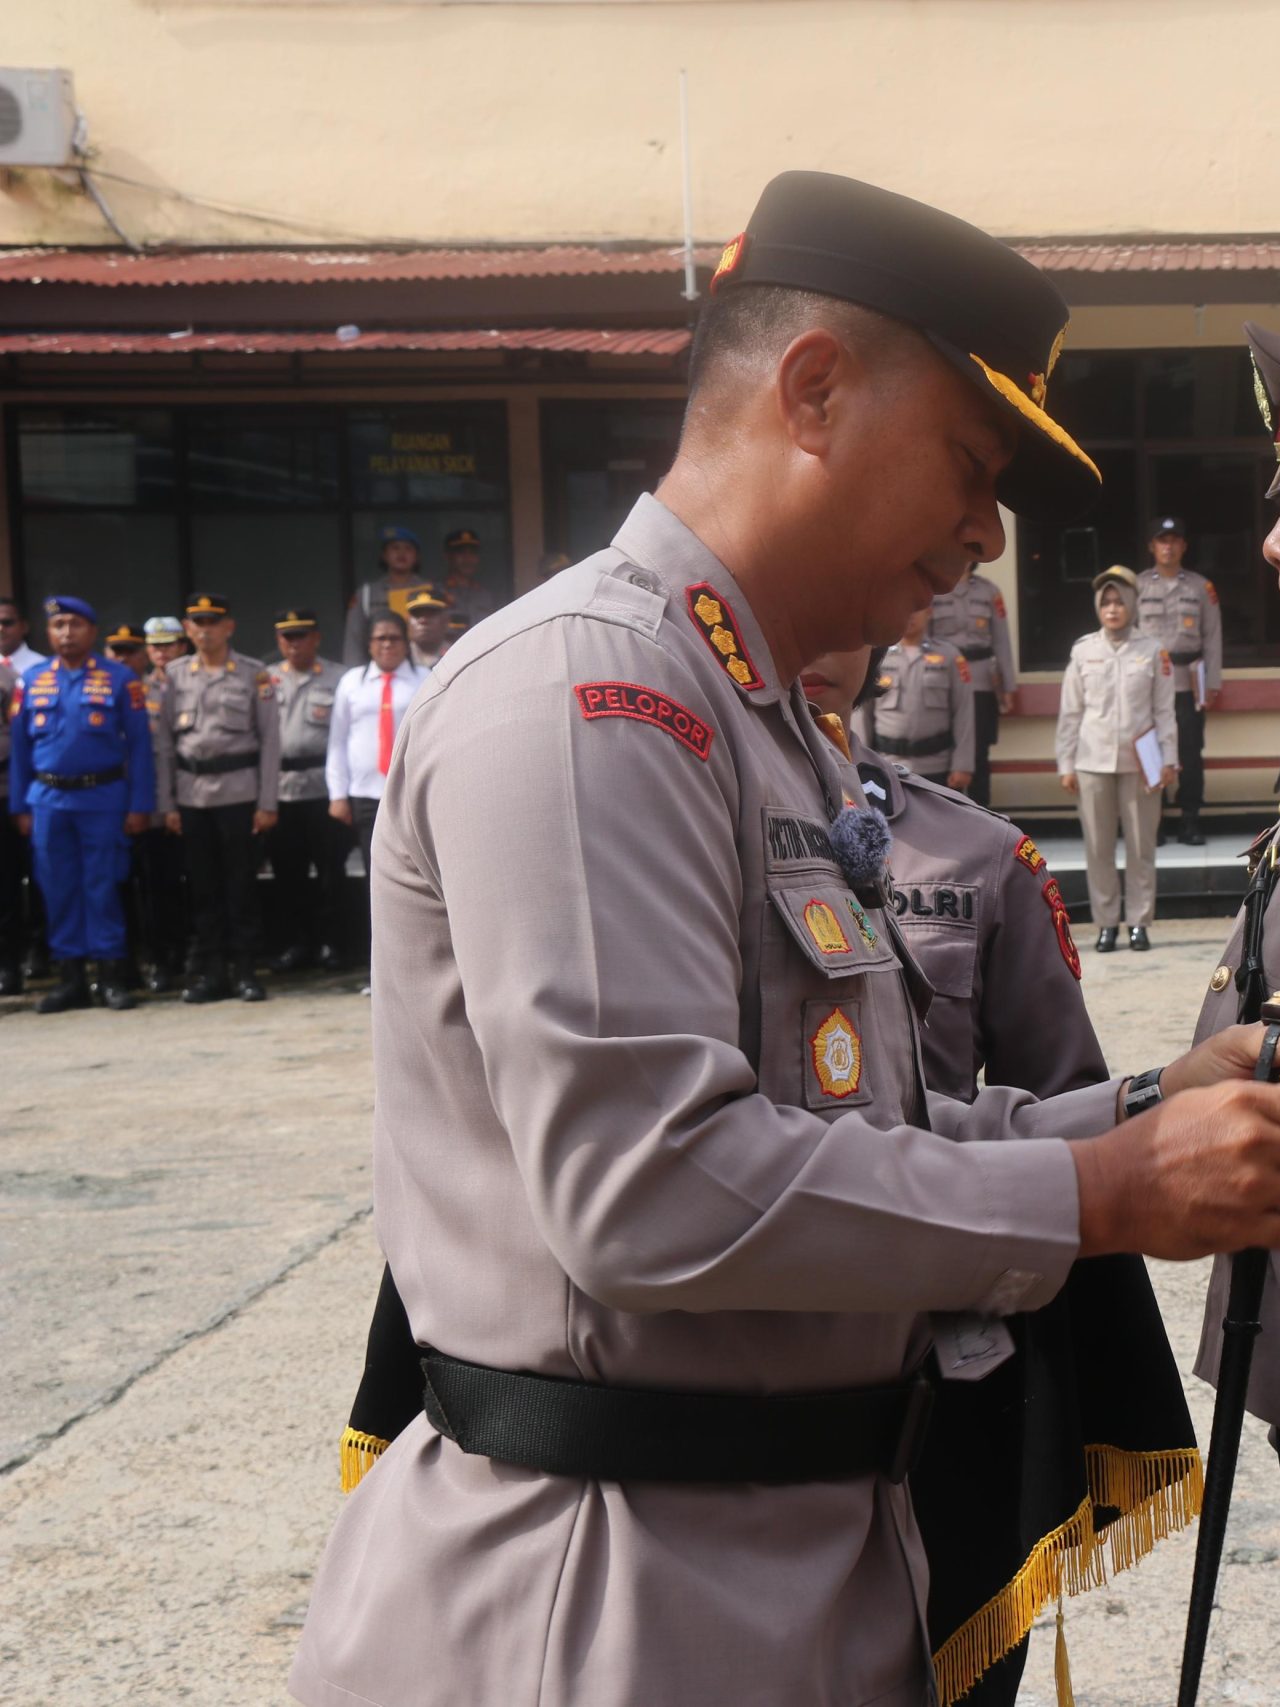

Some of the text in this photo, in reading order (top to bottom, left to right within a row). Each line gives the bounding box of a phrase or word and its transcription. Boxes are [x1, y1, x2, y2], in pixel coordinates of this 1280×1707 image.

[586, 689, 705, 748] PELOPOR
[768, 817, 808, 860] VICTOR
[894, 888, 973, 919] OLRI
